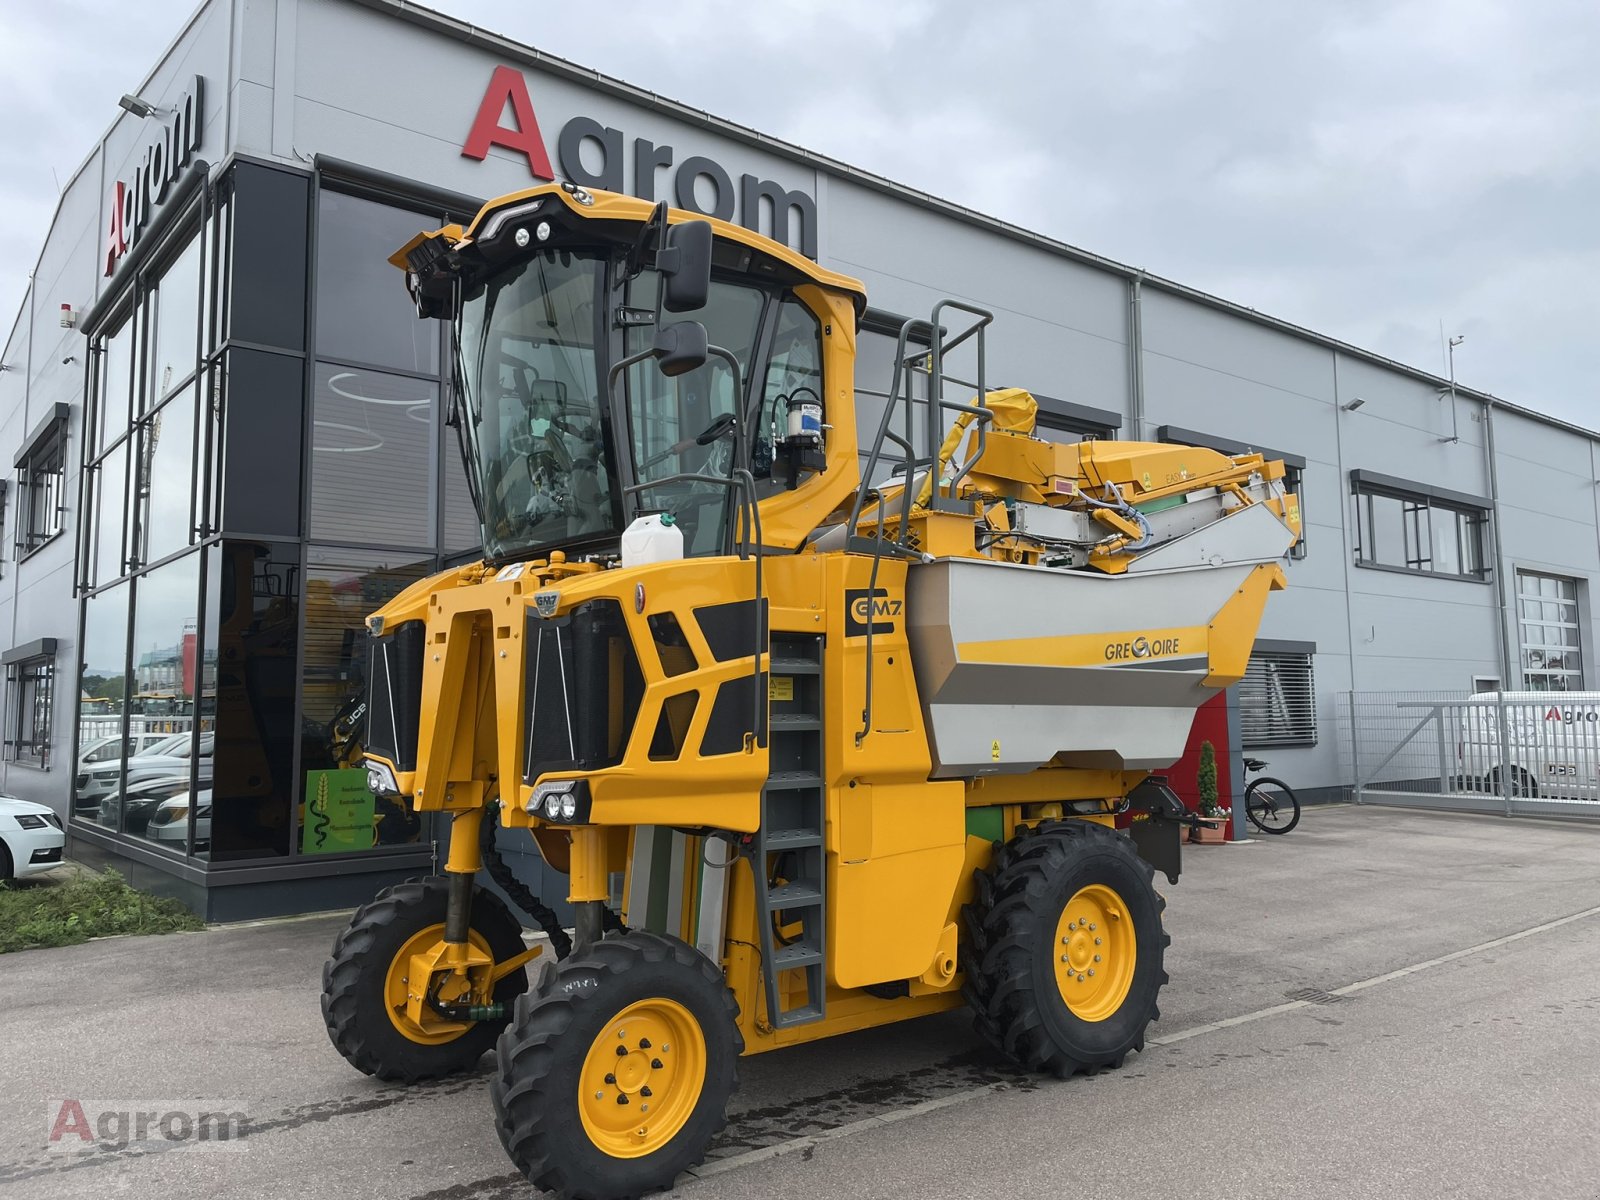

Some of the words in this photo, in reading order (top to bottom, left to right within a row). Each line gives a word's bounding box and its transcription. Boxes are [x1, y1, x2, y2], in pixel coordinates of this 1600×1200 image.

[103, 74, 204, 278] Agrom
[461, 65, 817, 262] Agrom
[1105, 636, 1179, 660] GREGOIRE
[349, 703, 367, 725] JCB
